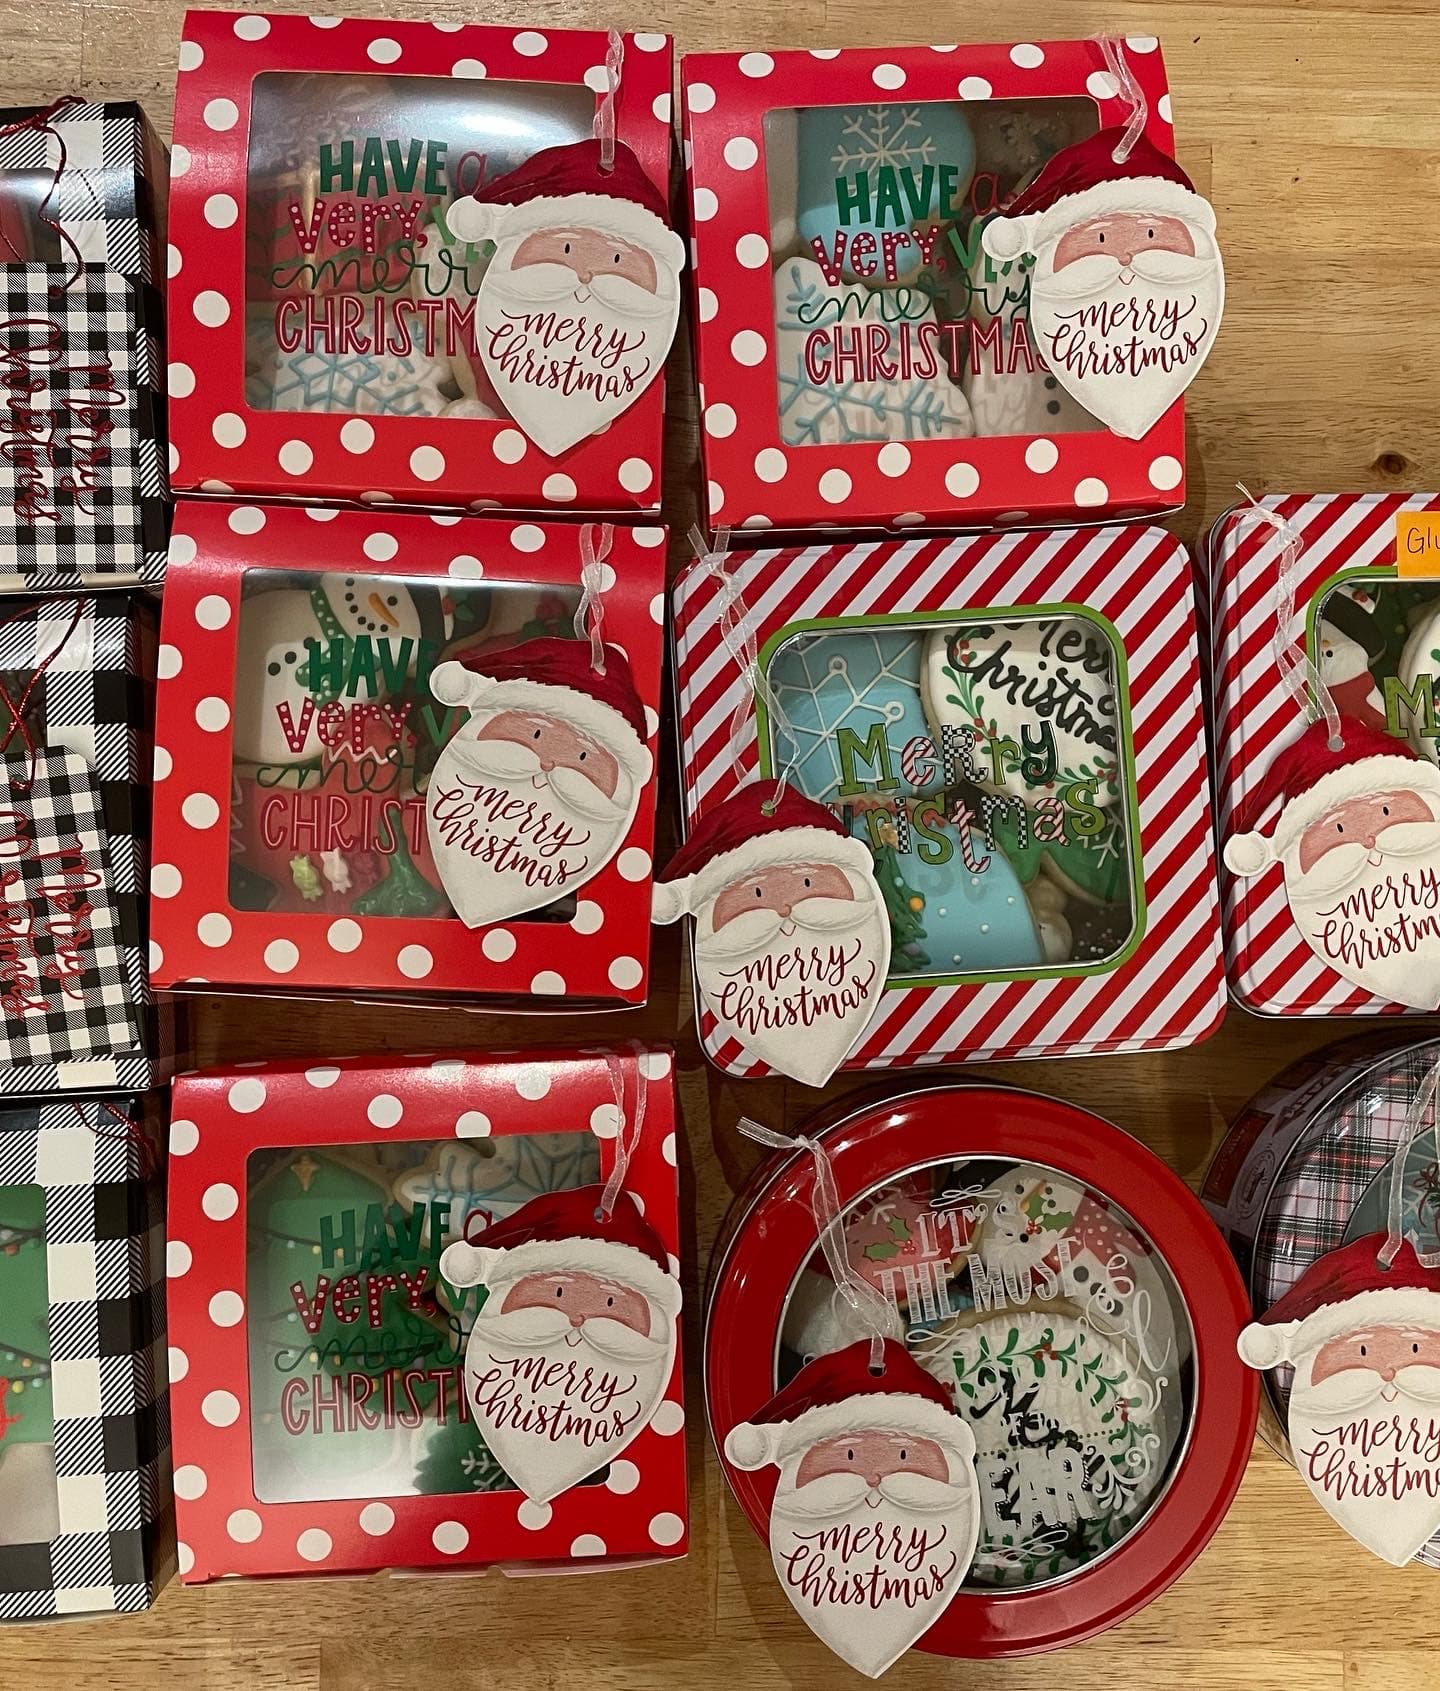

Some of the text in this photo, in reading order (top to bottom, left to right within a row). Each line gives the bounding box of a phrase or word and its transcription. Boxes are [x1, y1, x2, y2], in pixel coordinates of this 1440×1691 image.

[320, 137, 448, 197] HAVE
[835, 164, 959, 228] HAVE
[271, 245, 479, 297] merr
[275, 295, 477, 357] CHRISTM
[501, 309, 646, 369] merry
[1044, 318, 1208, 380] Christmas
[1054, 294, 1198, 341] merry
[486, 325, 650, 402] Christmas
[58, 350, 126, 515] Merry
[309, 635, 435, 698] HAVE
[946, 624, 1117, 754] Christma
[261, 793, 426, 856] CHRIST
[436, 785, 588, 887] Christmas
[456, 774, 591, 856] merry
[30, 833, 102, 1000] Merry
[1316, 867, 1440, 923] merry
[719, 937, 862, 992] merry
[1311, 912, 1440, 970] Christm
[710, 959, 876, 1036] Christmas
[320, 1201, 451, 1270] HAVE
[872, 1235, 1082, 1325] THE MOST
[274, 1314, 471, 1373] merr
[472, 1367, 642, 1448] Christmas
[488, 1354, 638, 1414] merry
[976, 1446, 1098, 1538] EAR
[779, 1544, 957, 1610] Christmas
[791, 1521, 947, 1572] merry
